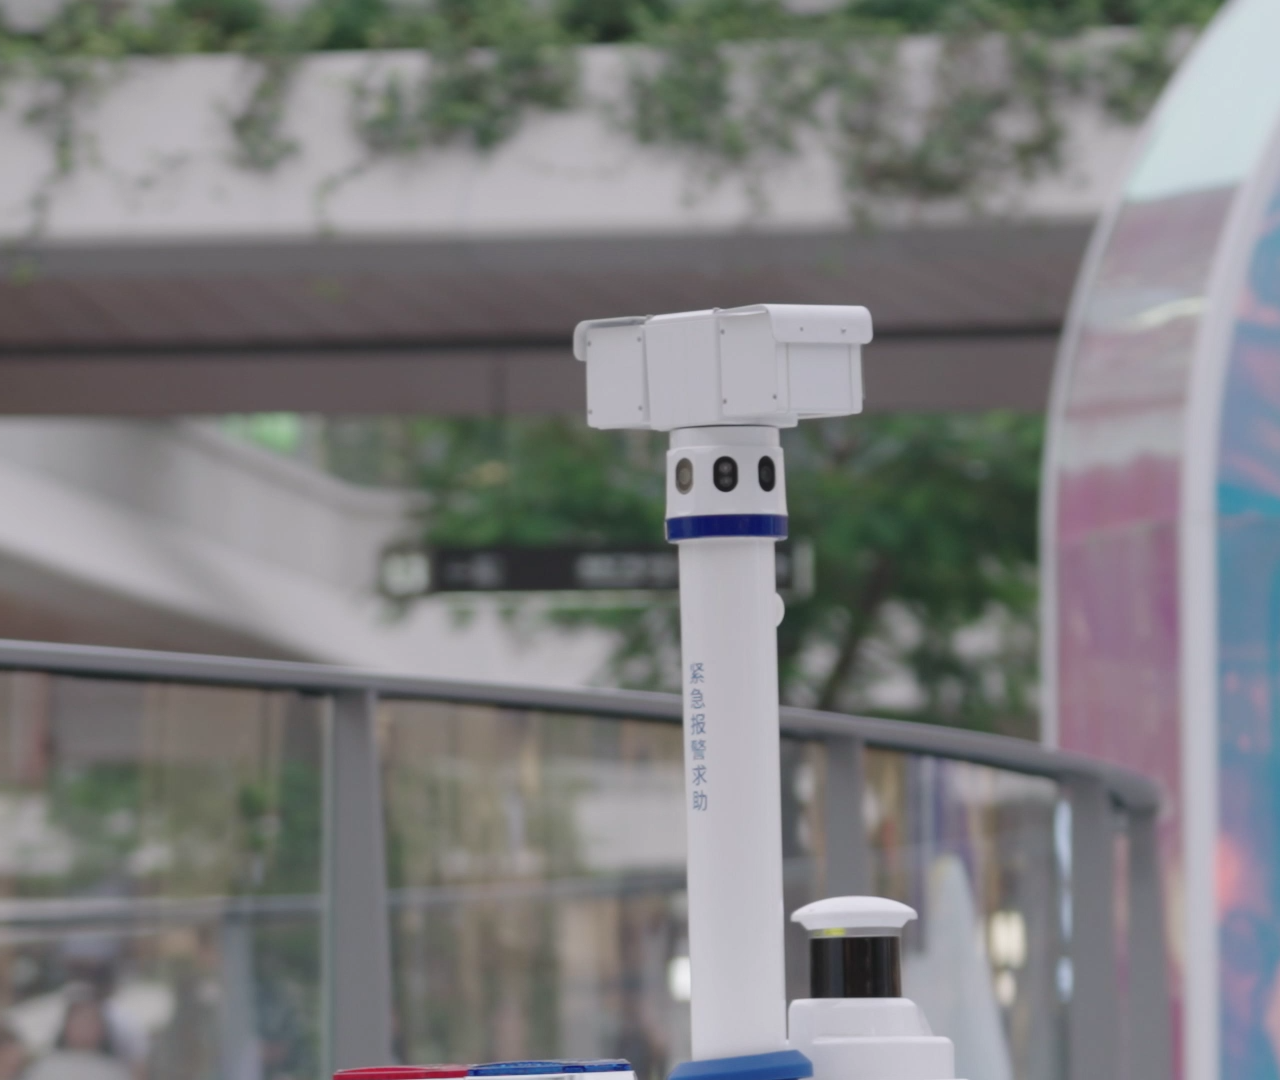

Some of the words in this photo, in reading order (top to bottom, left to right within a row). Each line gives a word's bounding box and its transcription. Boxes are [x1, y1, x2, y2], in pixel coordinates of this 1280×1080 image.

[690, 662, 708, 812] 紧急报警求助
